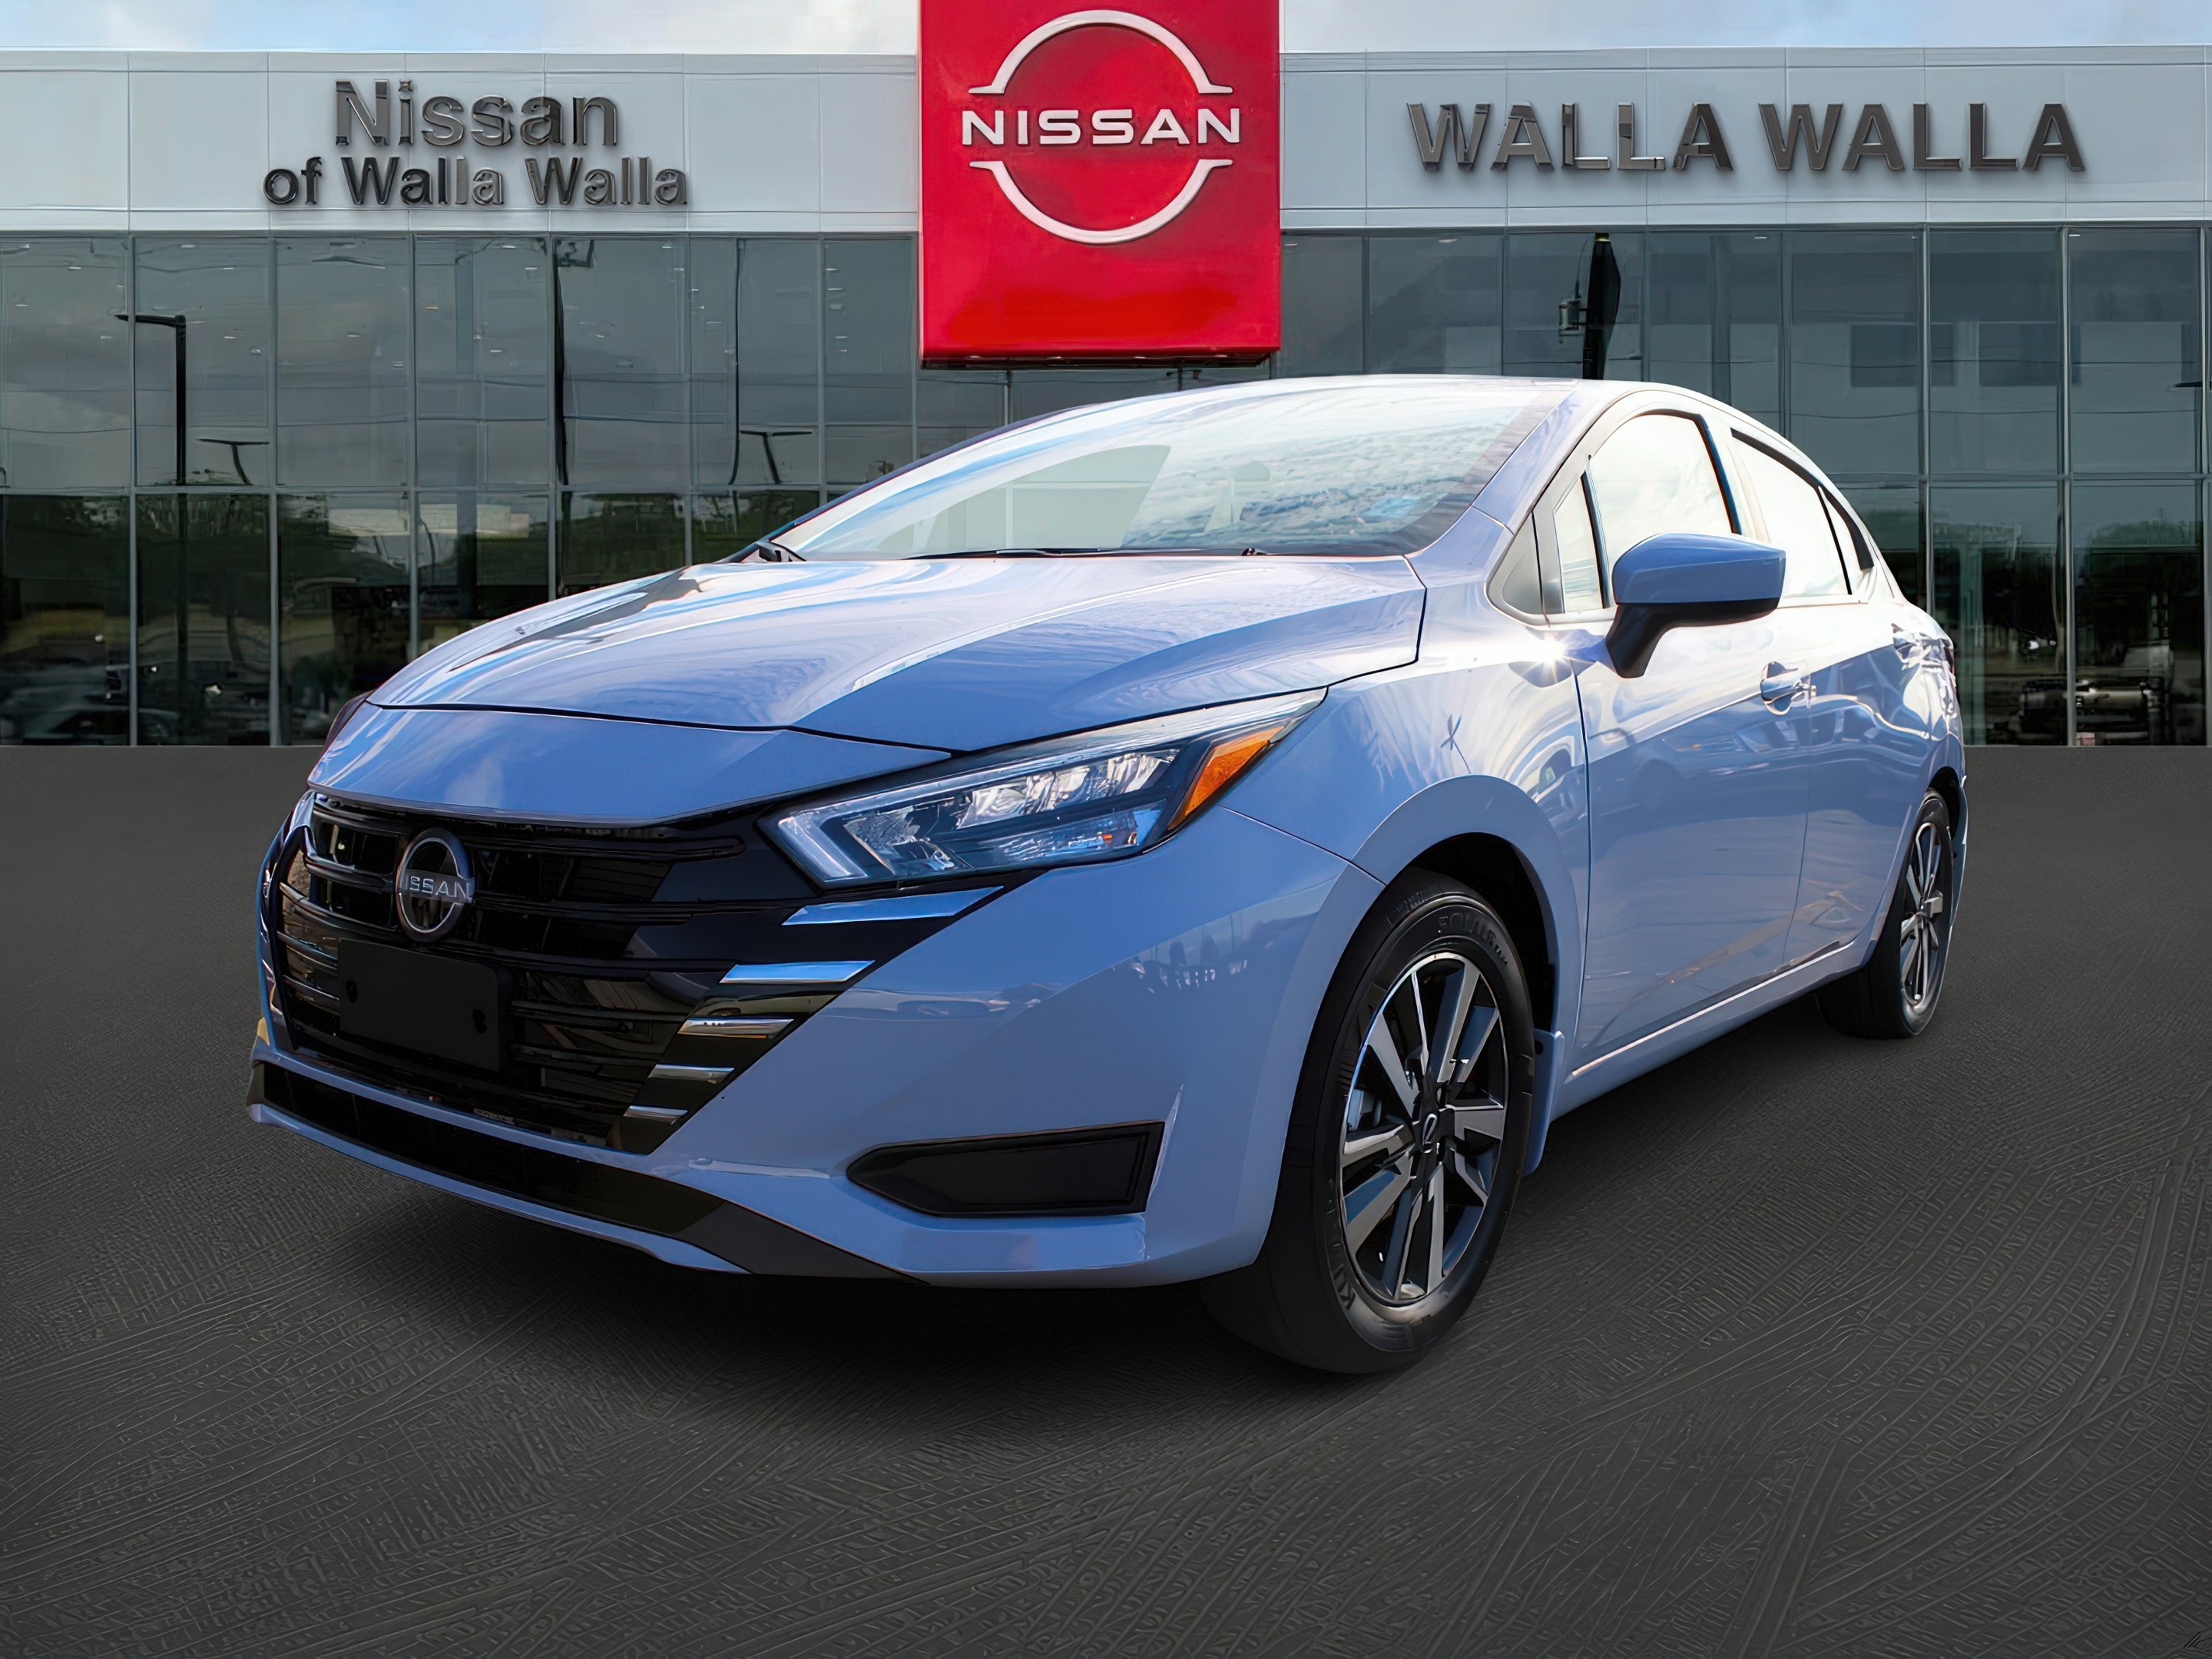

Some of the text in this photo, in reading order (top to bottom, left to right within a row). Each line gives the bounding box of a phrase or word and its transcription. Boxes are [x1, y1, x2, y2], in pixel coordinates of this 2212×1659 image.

[335, 79, 618, 146] Nissan
[962, 108, 1240, 145] NISSAN
[1407, 102, 2086, 171] WALLA WALLA
[263, 156, 689, 205] of Walla Walla
